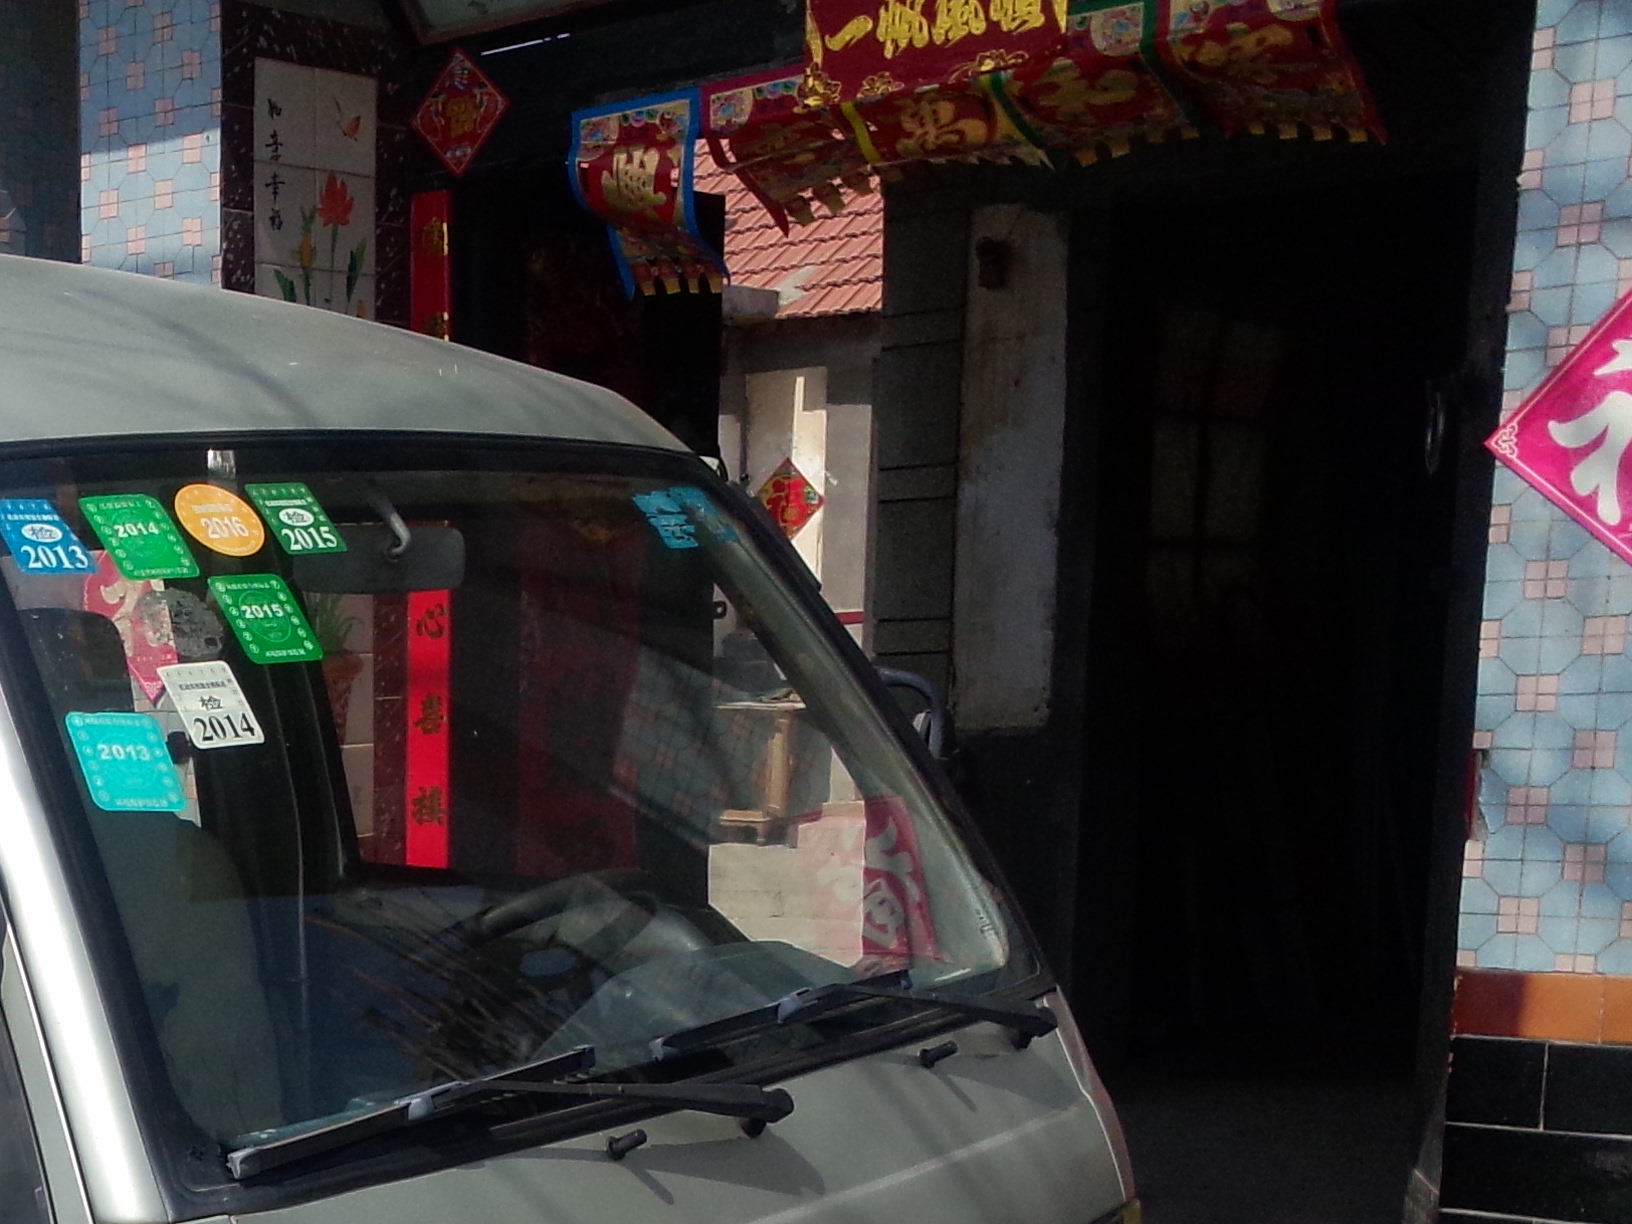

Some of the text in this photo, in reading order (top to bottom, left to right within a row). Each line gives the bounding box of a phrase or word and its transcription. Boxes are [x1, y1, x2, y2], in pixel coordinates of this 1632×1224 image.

[114, 521, 160, 538] 2014
[200, 516, 249, 539] 2016
[281, 526, 338, 551] 2015
[20, 545, 89, 569] 2013
[240, 603, 284, 619] 2015
[193, 712, 256, 743] 2014
[96, 743, 150, 761] 2013
